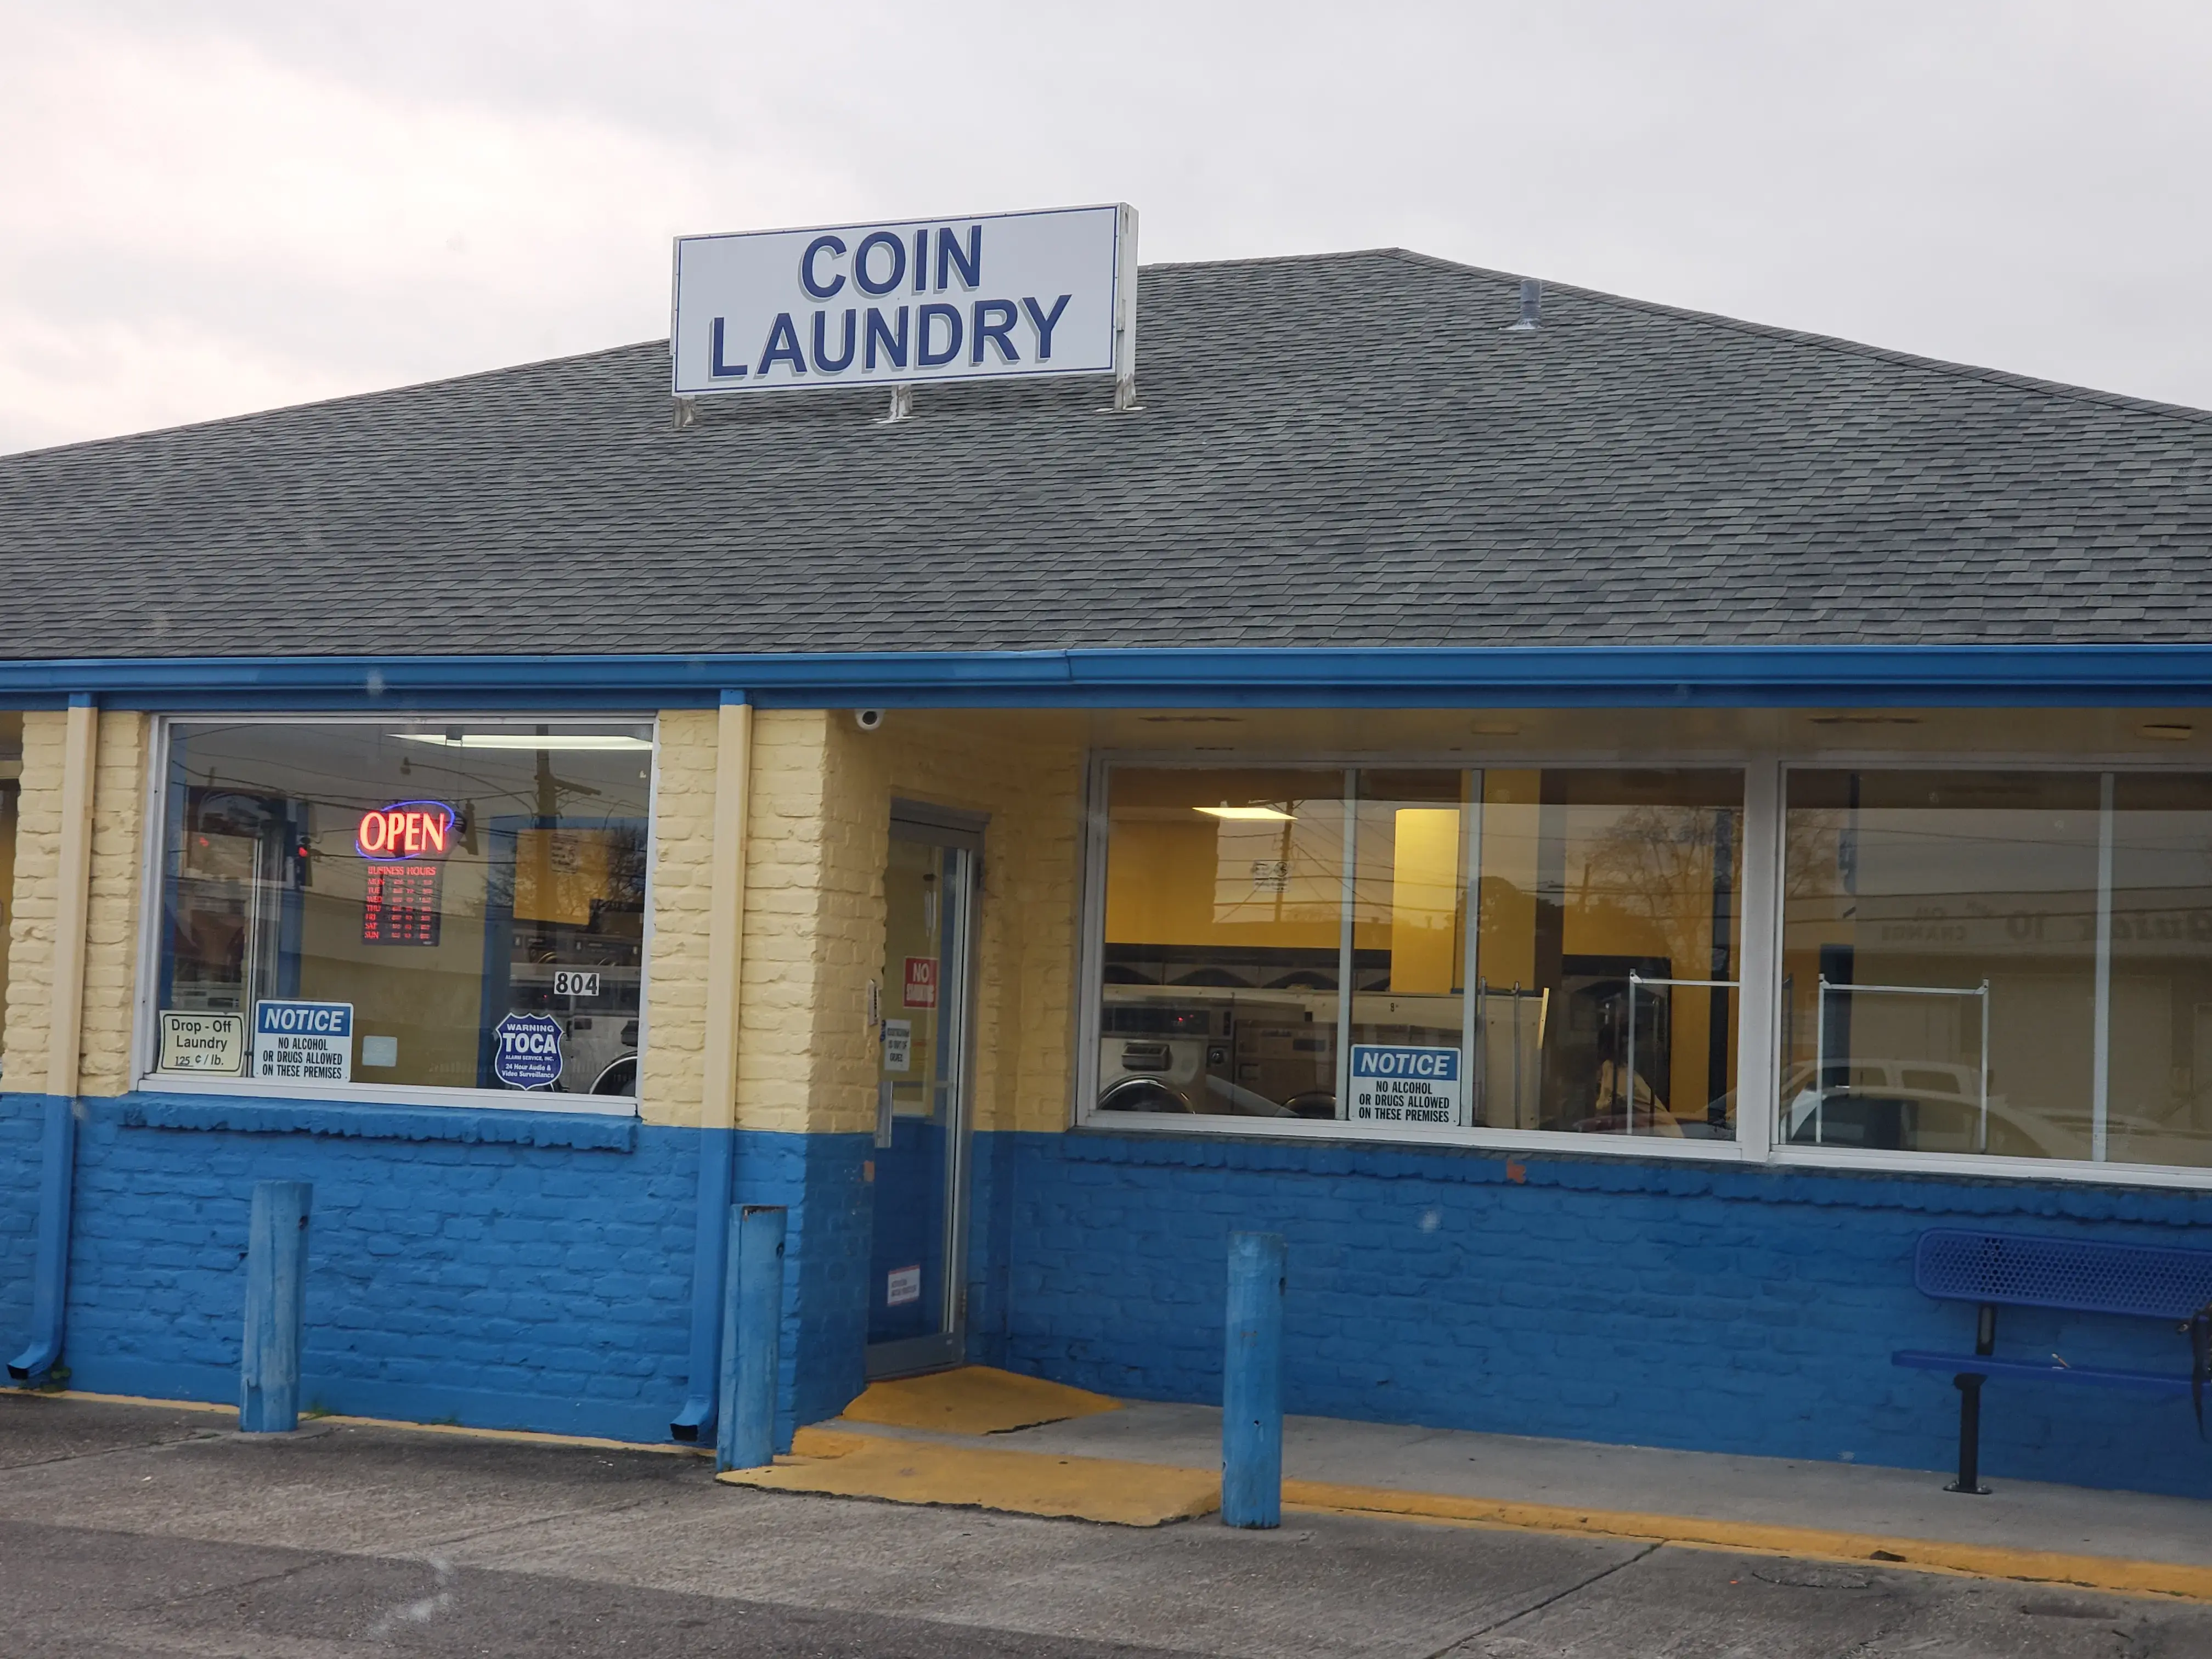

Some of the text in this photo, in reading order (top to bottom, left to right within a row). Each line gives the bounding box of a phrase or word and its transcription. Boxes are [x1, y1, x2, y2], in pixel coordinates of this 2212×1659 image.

[799, 224, 982, 300] COIN
[709, 294, 1073, 379] LAUNDRY
[359, 811, 445, 851] OPEN
[368, 866, 436, 876] BUSINESS HOURS
[913, 963, 929, 983] NO
[555, 973, 598, 995] 804
[172, 1019, 201, 1034] Drop
[213, 1020, 232, 1033] Off
[264, 1008, 345, 1031] NOTICE
[506, 1024, 555, 1032] WARNING
[177, 1035, 228, 1052] Laundry
[278, 1037, 329, 1051] NO ALCOHOL
[503, 1032, 557, 1054] TOCA
[263, 1051, 342, 1065] OR DRUGS ALLOWED
[1361, 1052, 1450, 1076] NOTICE
[262, 1064, 342, 1079] ON THESE PREMISES
[1376, 1080, 1432, 1094] NO ALCOHOL
[1359, 1093, 1449, 1109] OR DRUGS ALLOWED
[1359, 1107, 1449, 1122] ON THESE PREMISES
